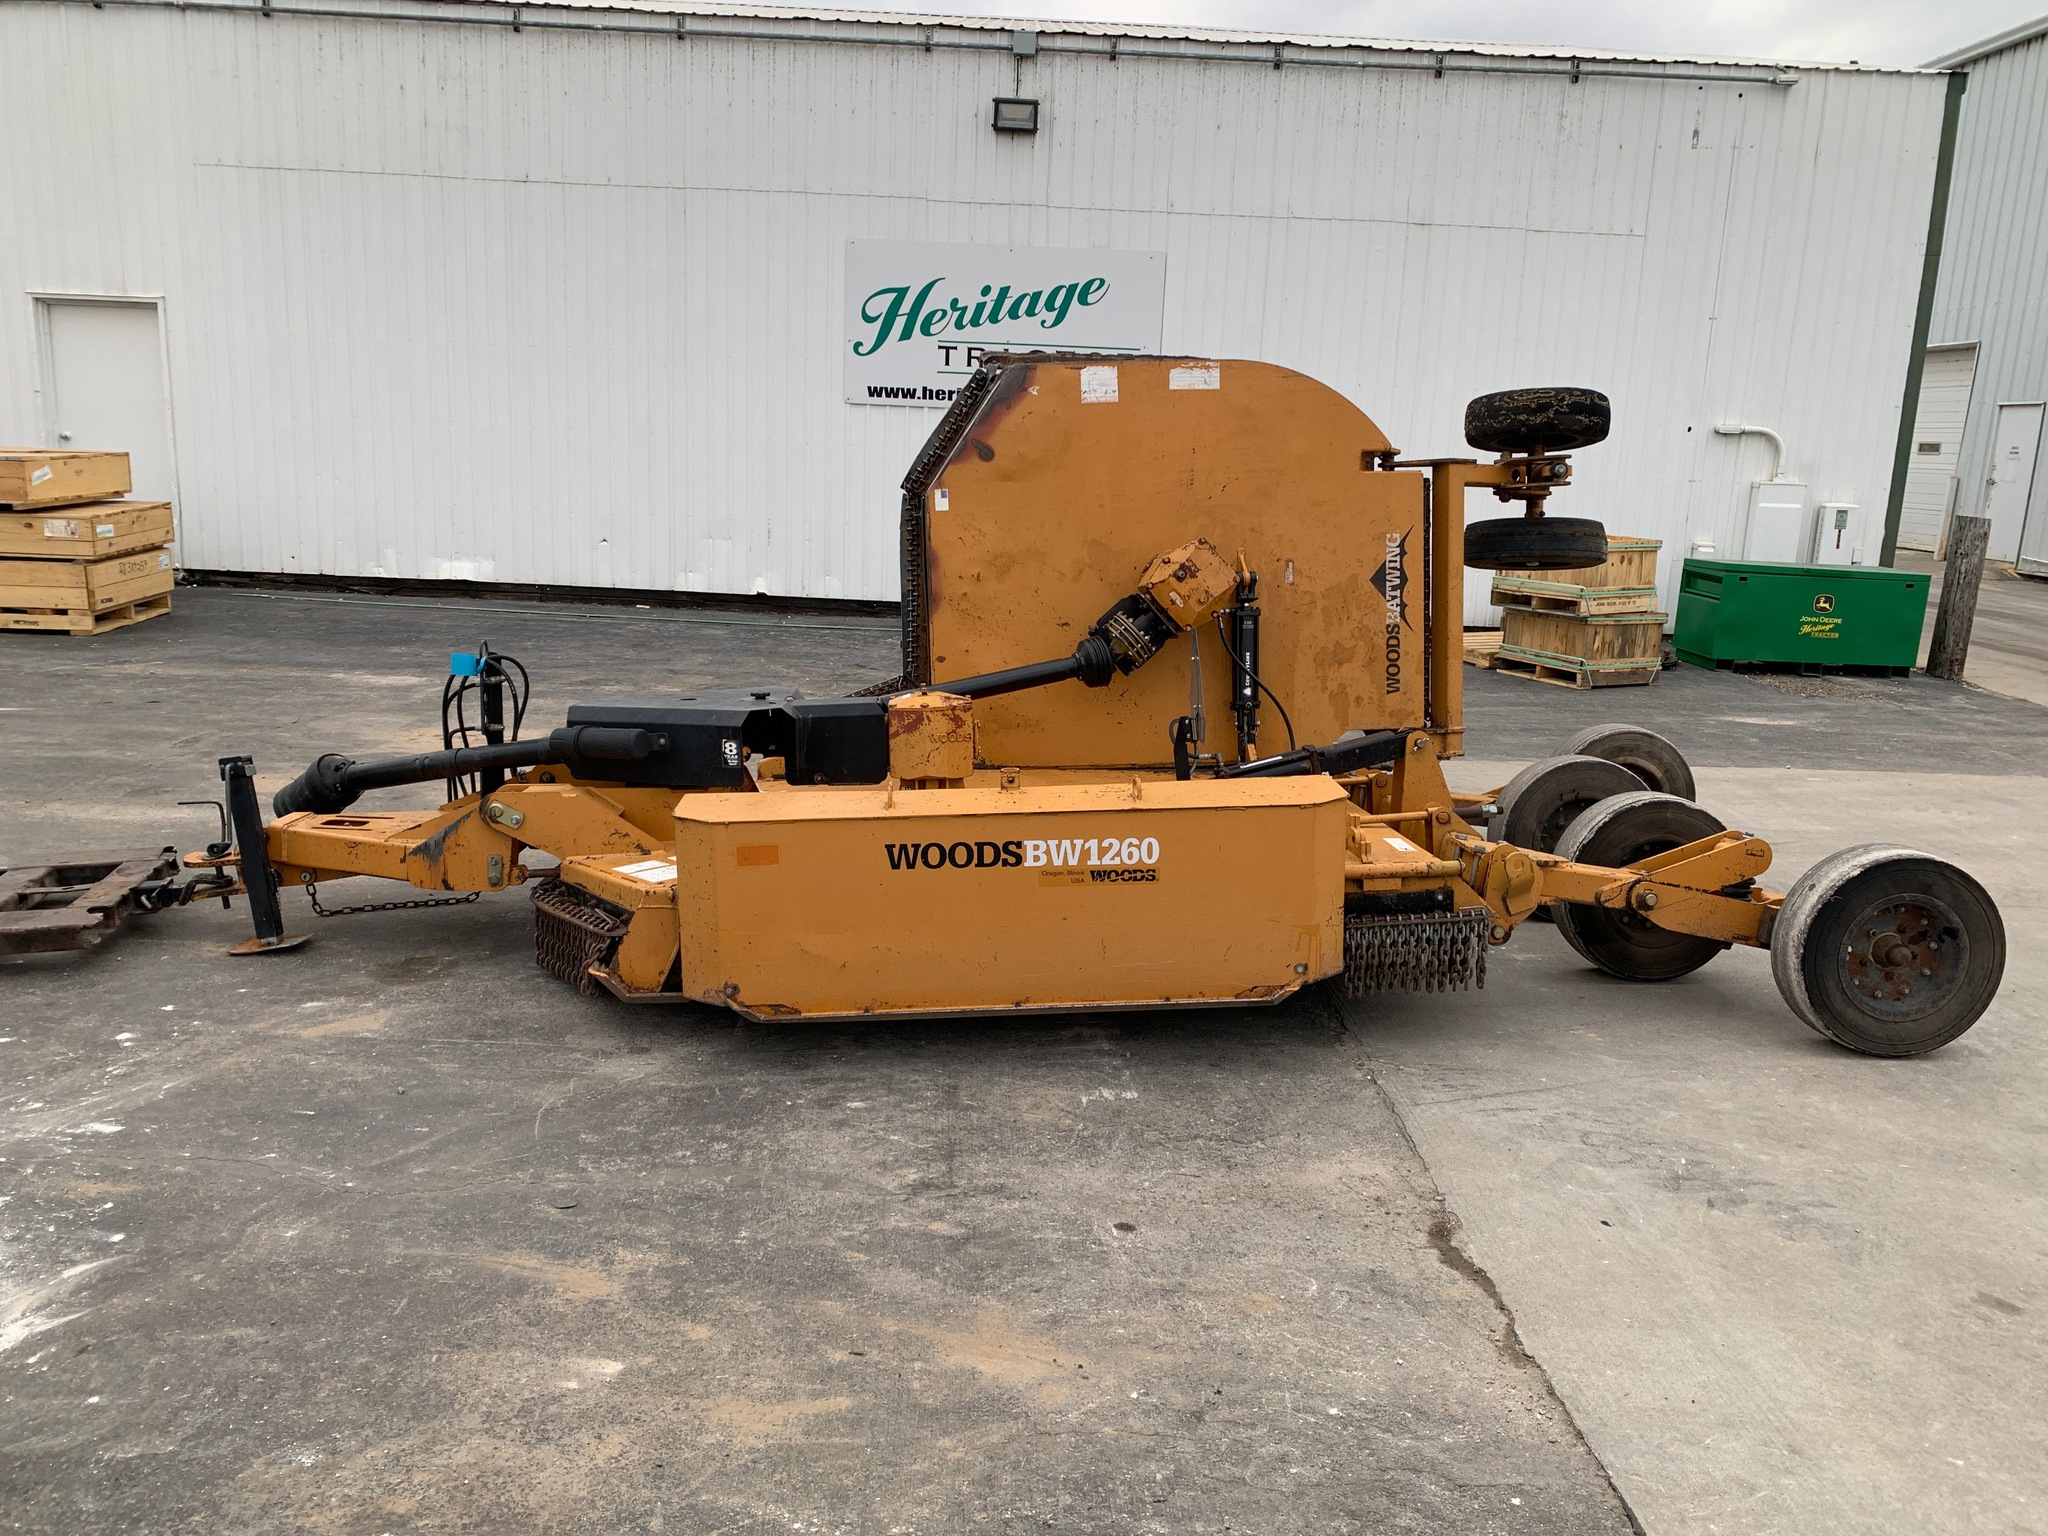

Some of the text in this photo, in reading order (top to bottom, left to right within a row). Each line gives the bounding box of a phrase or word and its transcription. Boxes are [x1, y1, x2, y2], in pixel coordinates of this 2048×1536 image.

[853, 277, 1110, 356] Heritage
[1820, 616, 1843, 624] DEERE
[1798, 624, 1835, 635] Heritage
[725, 742, 737, 754] 8
